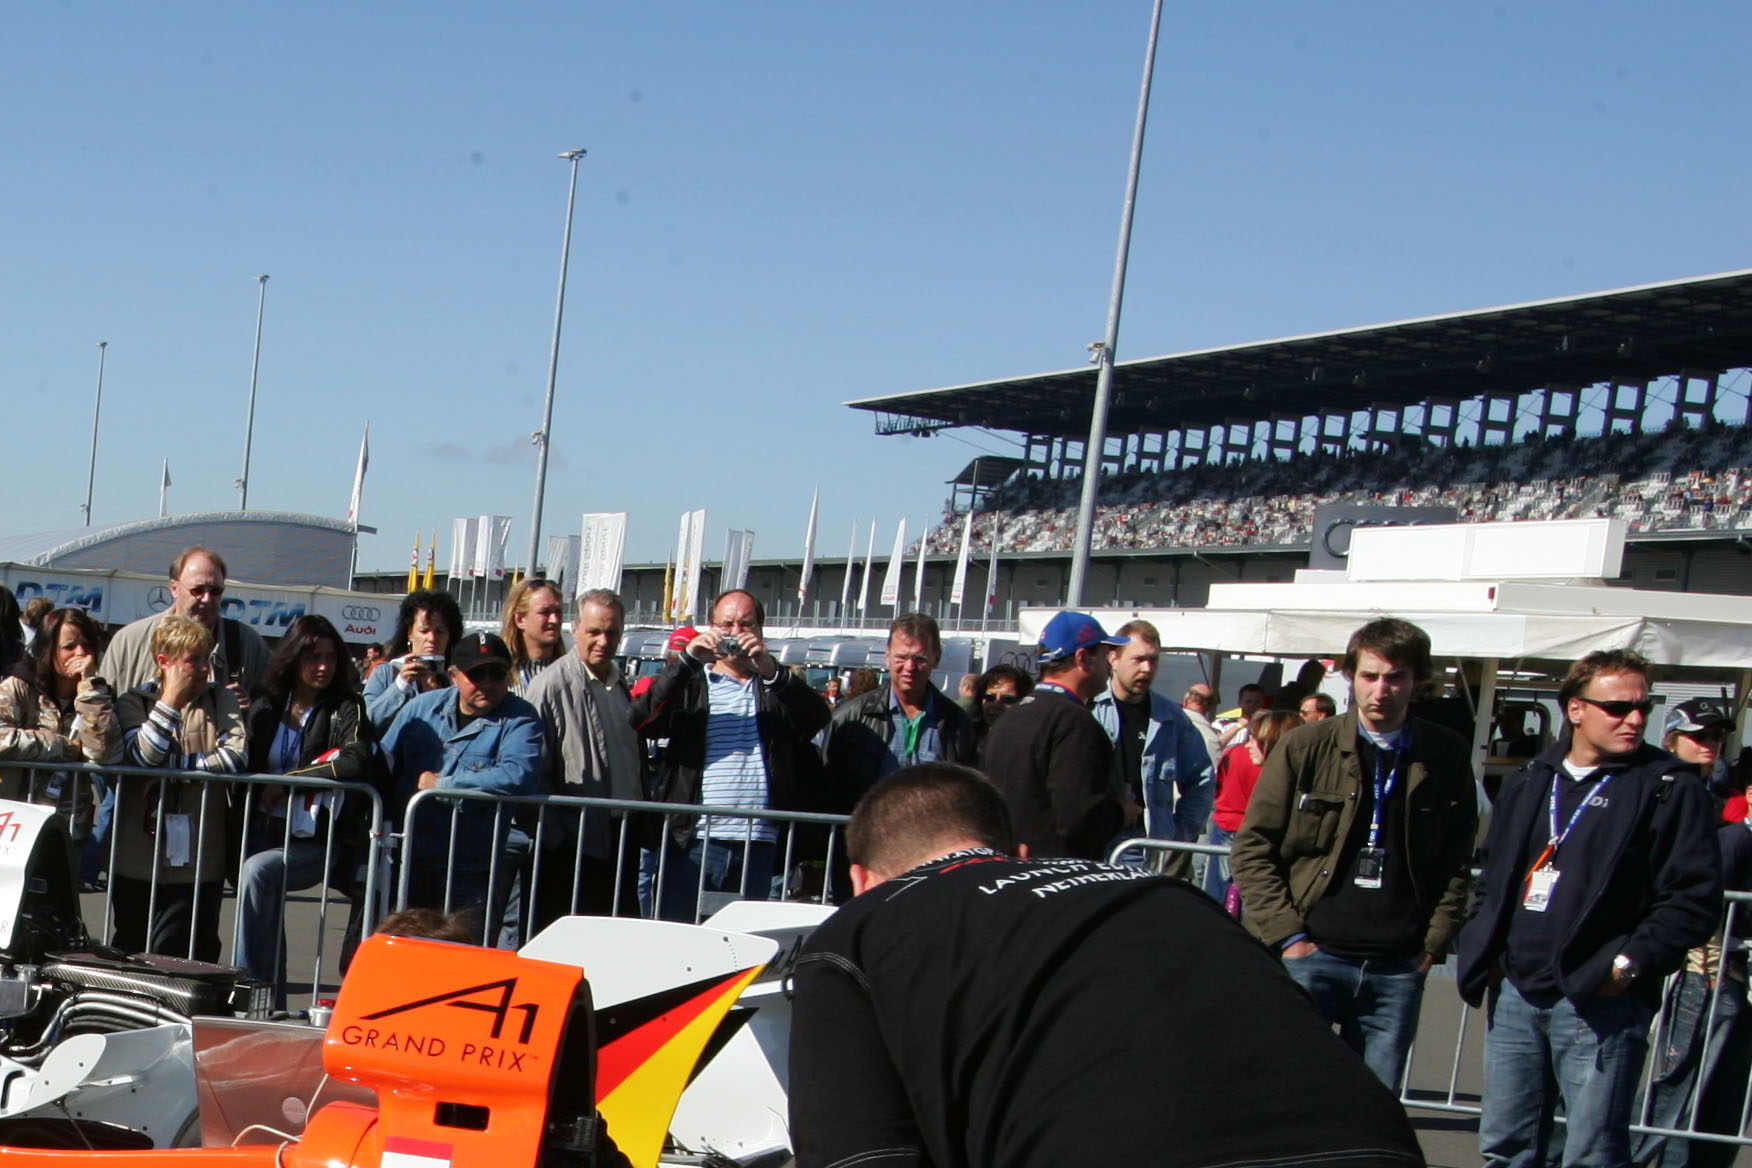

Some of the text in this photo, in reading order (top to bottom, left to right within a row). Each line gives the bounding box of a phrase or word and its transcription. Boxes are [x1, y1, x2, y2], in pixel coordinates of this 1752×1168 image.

[15, 581, 103, 612] DTM
[220, 597, 306, 627] DTM
[344, 624, 377, 635] Audi
[978, 863, 1088, 895] LAUNCH
[358, 977, 539, 1045] A1
[342, 1026, 446, 1057] GRAND
[461, 1043, 526, 1072] PRIX
